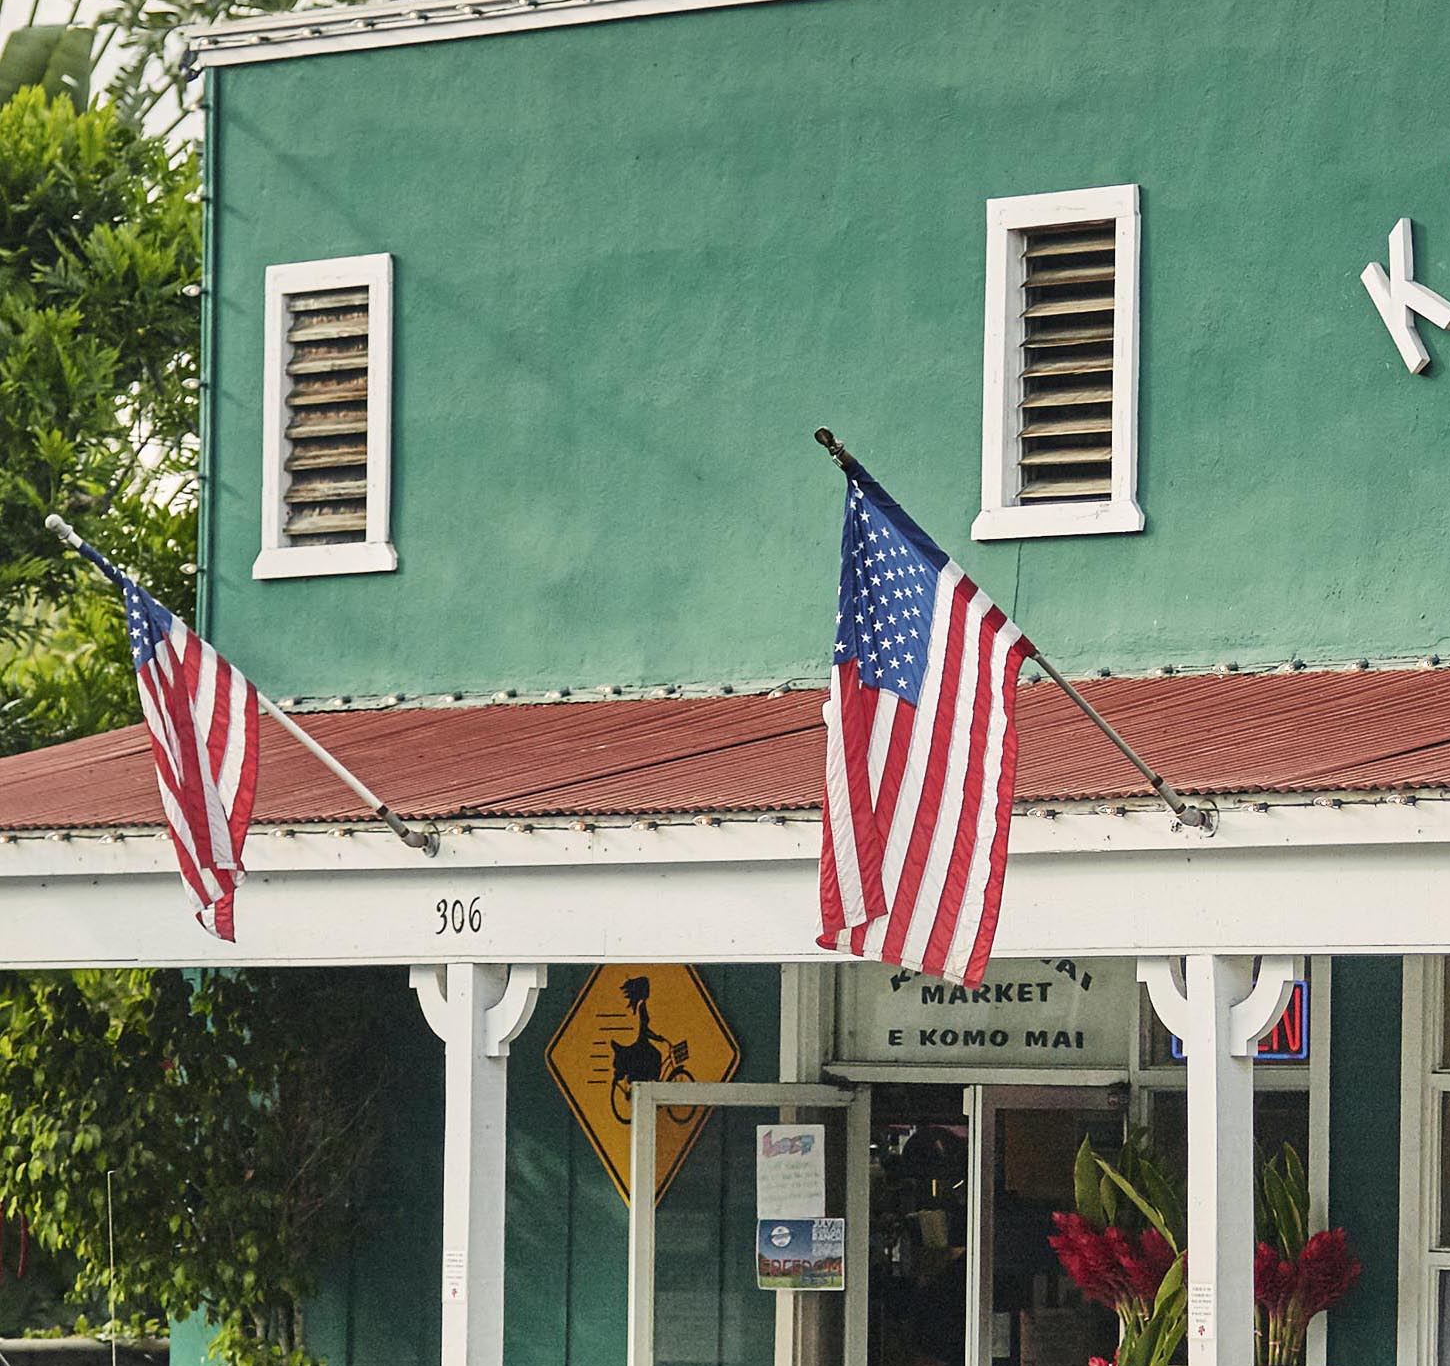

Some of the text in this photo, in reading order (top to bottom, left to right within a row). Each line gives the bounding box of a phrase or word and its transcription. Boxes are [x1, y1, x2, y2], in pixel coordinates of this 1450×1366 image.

[435, 896, 482, 935] 306
[921, 981, 1053, 1005] MARKET
[888, 1028, 1084, 1049] E KOMO MAI
